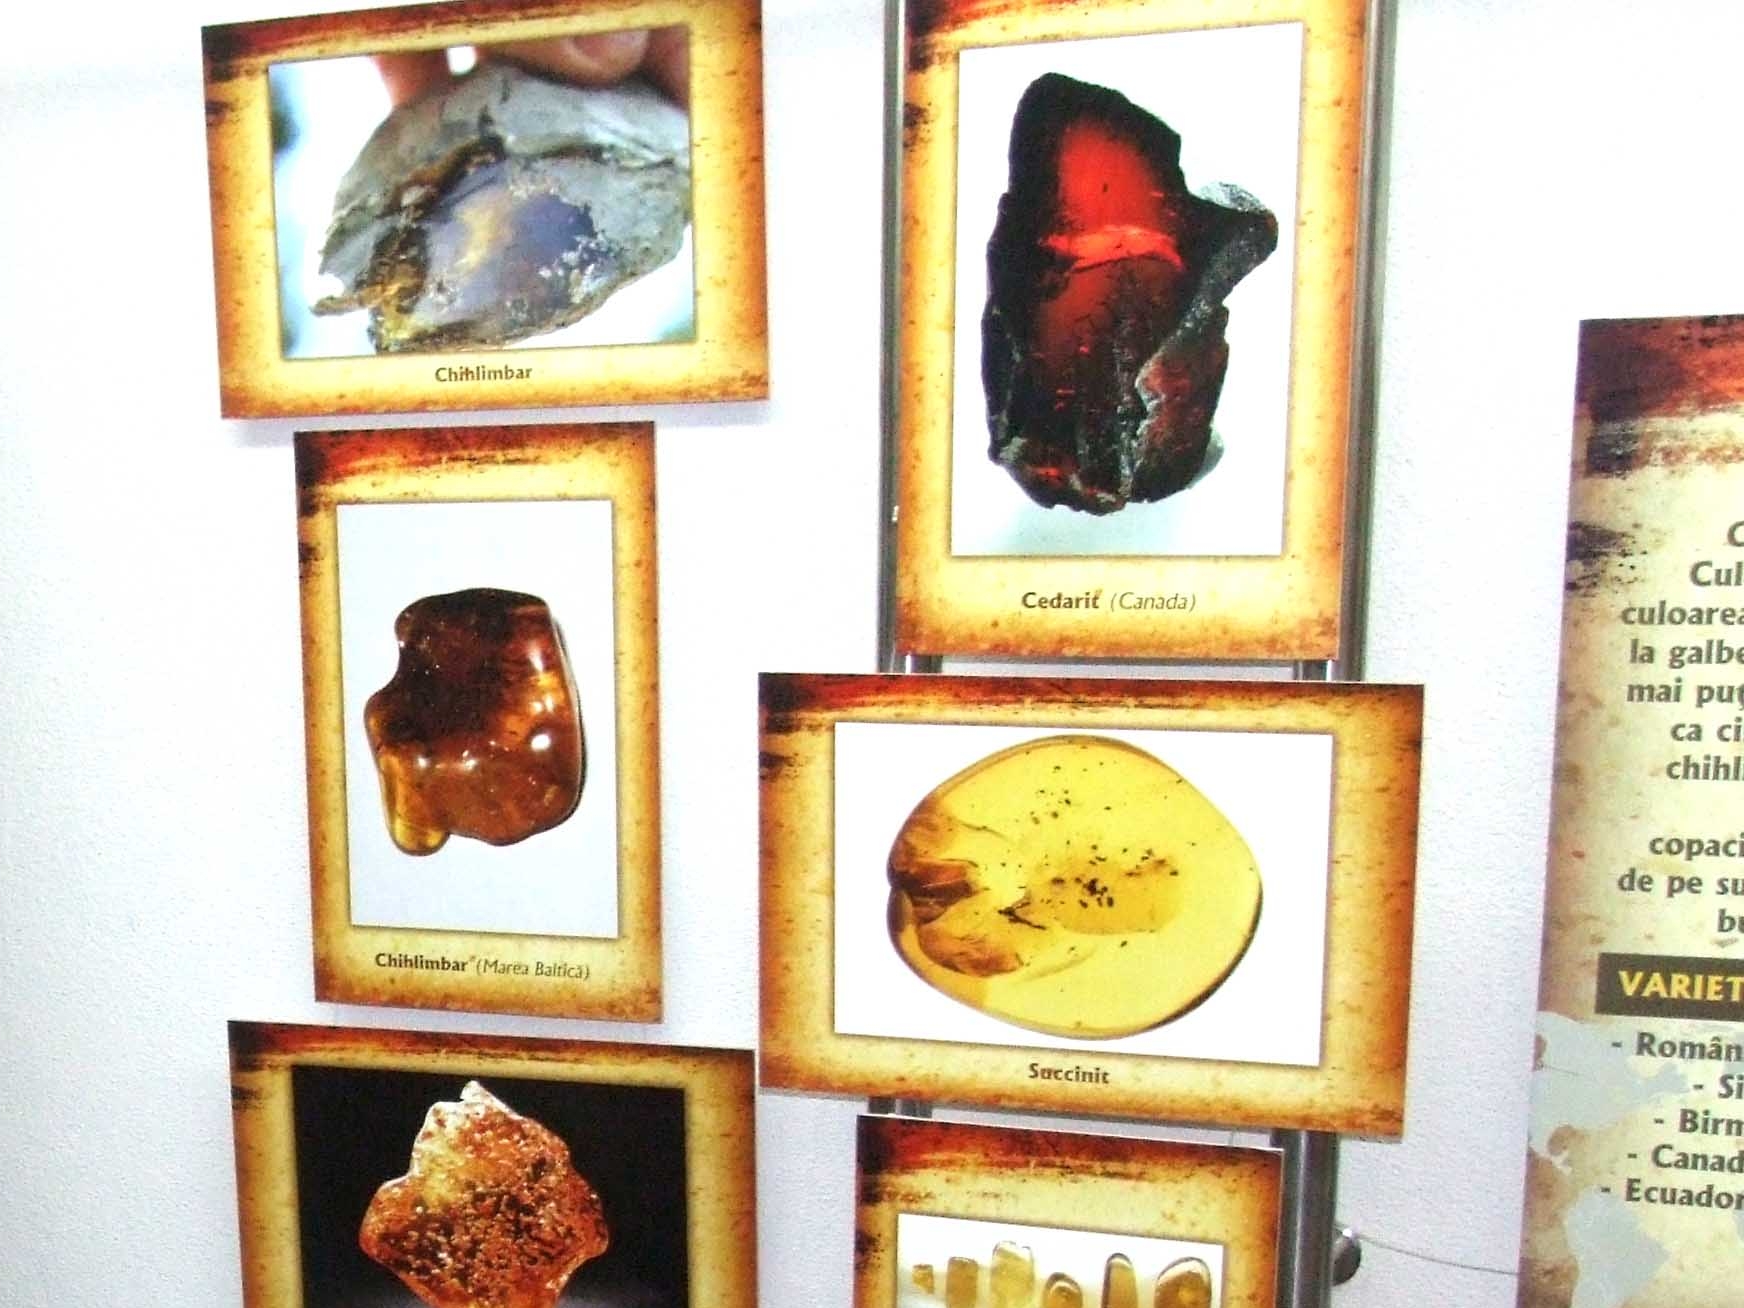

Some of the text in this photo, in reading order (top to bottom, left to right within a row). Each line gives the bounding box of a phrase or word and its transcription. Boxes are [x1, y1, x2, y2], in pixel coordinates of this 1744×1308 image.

[435, 364, 533, 382] Chihlimbar
[1021, 592, 1196, 612] Cedarit (Canada)
[1629, 638, 1655, 664] la
[1627, 677, 1683, 702] mai
[1670, 716, 1744, 742] ca ci
[1666, 754, 1744, 781] chihl
[1649, 832, 1744, 861] copaci
[1618, 867, 1653, 892] de
[1667, 874, 1703, 898] pe
[375, 953, 468, 972] Chihlimbar
[476, 959, 529, 976] (Marea
[1618, 970, 1744, 1002] VARIET
[1635, 1032, 1743, 1062] Român
[1029, 1063, 1109, 1084] Succinit
